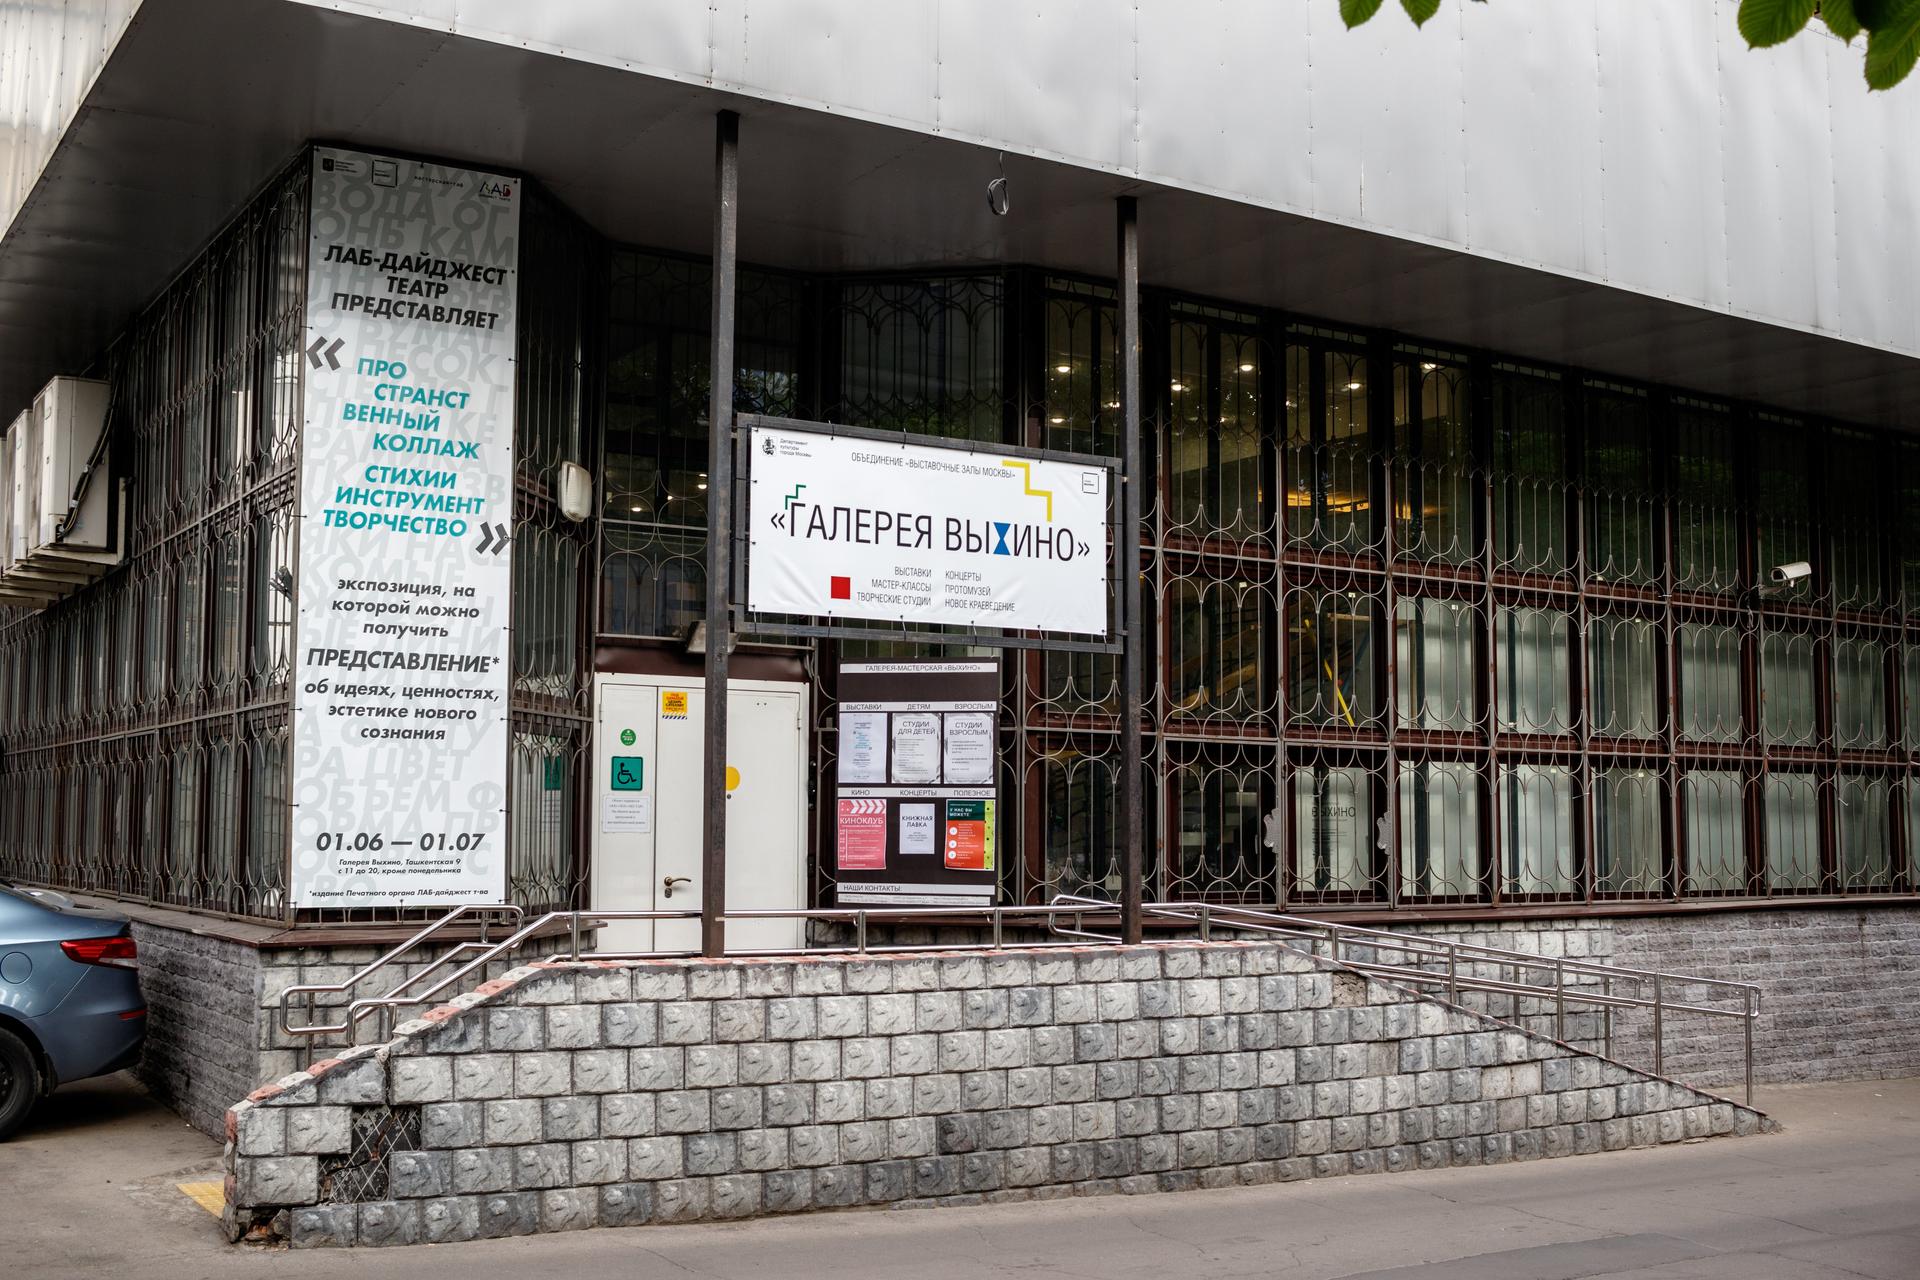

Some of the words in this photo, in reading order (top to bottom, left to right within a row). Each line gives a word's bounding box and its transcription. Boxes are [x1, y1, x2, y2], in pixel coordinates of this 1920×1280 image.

[324, 245, 507, 285] ЛАБ-ДАЙДЖЕСТ
[387, 275, 449, 299] ТЕАТР
[331, 292, 499, 329] ПРЕДСТАВЛЯЕТ
[357, 357, 407, 380] ПРО
[374, 383, 470, 410] СТРАНСТ
[342, 403, 441, 432] ВЕННЫЙ
[372, 433, 481, 460] КОЛЛАЖ
[851, 452, 904, 467] ОБЪЕДИНЕНИЕ
[961, 465, 981, 475] ЗАЛЫ
[364, 464, 457, 489] СТИХИИ
[335, 486, 485, 515] ИНСТРУМЕНТ
[323, 509, 468, 537] ТВОРЧЕСТВО
[770, 502, 932, 550] «ГАЛЕРЕЯ
[945, 517, 1090, 561] ВЫХИНО»
[894, 566, 932, 578] ВЫСТАВКИ
[945, 570, 982, 582] КОНЦЕРТЫ
[337, 578, 447, 598] экспозиция,
[453, 586, 476, 597] на
[871, 578, 932, 592] МАСТЕР-КЛАССЫ
[944, 583, 991, 597] ПРОТОМУЗЕЙ
[856, 591, 902, 606] ТВОРЧЕСКИЕ
[903, 595, 932, 607] СТУДИИ
[944, 598, 968, 609] НОВОЕ
[969, 600, 1016, 612] КРАЕВЕДЕНИЕ
[332, 599, 410, 617] которой
[415, 605, 480, 618] можно
[363, 622, 449, 640] получить
[865, 664, 943, 672] ГАЛЕРЕЯ-МАСТЕРСКАЯ
[304, 678, 329, 694] об
[334, 683, 396, 699] идеях,
[401, 685, 500, 702] ценностях,
[328, 704, 409, 718] эстетике
[414, 706, 477, 720] нового
[907, 703, 931, 711] ДЕТЯМ
[360, 727, 446, 740] сознания
[912, 727, 936, 736] ДЕТЕЙ
[851, 789, 871, 797] КИНО
[900, 789, 938, 797] КОНЦЕРТЫ
[953, 789, 991, 797] ПОЛЕЗНОЕ
[839, 817, 884, 825] КИНОКЛУБ
[316, 832, 384, 851] 01.06
[419, 832, 486, 851] 01.07
[339, 858, 370, 866] Галерея
[372, 858, 404, 867] Выхино,
[405, 858, 454, 866] Ташкентская
[368, 867, 381, 875] 20,
[381, 868, 407, 876] кроме
[408, 867, 461, 875] понедельника
[346, 889, 388, 897] Печатного
[417, 889, 472, 897] ЛАБ-дайджест
